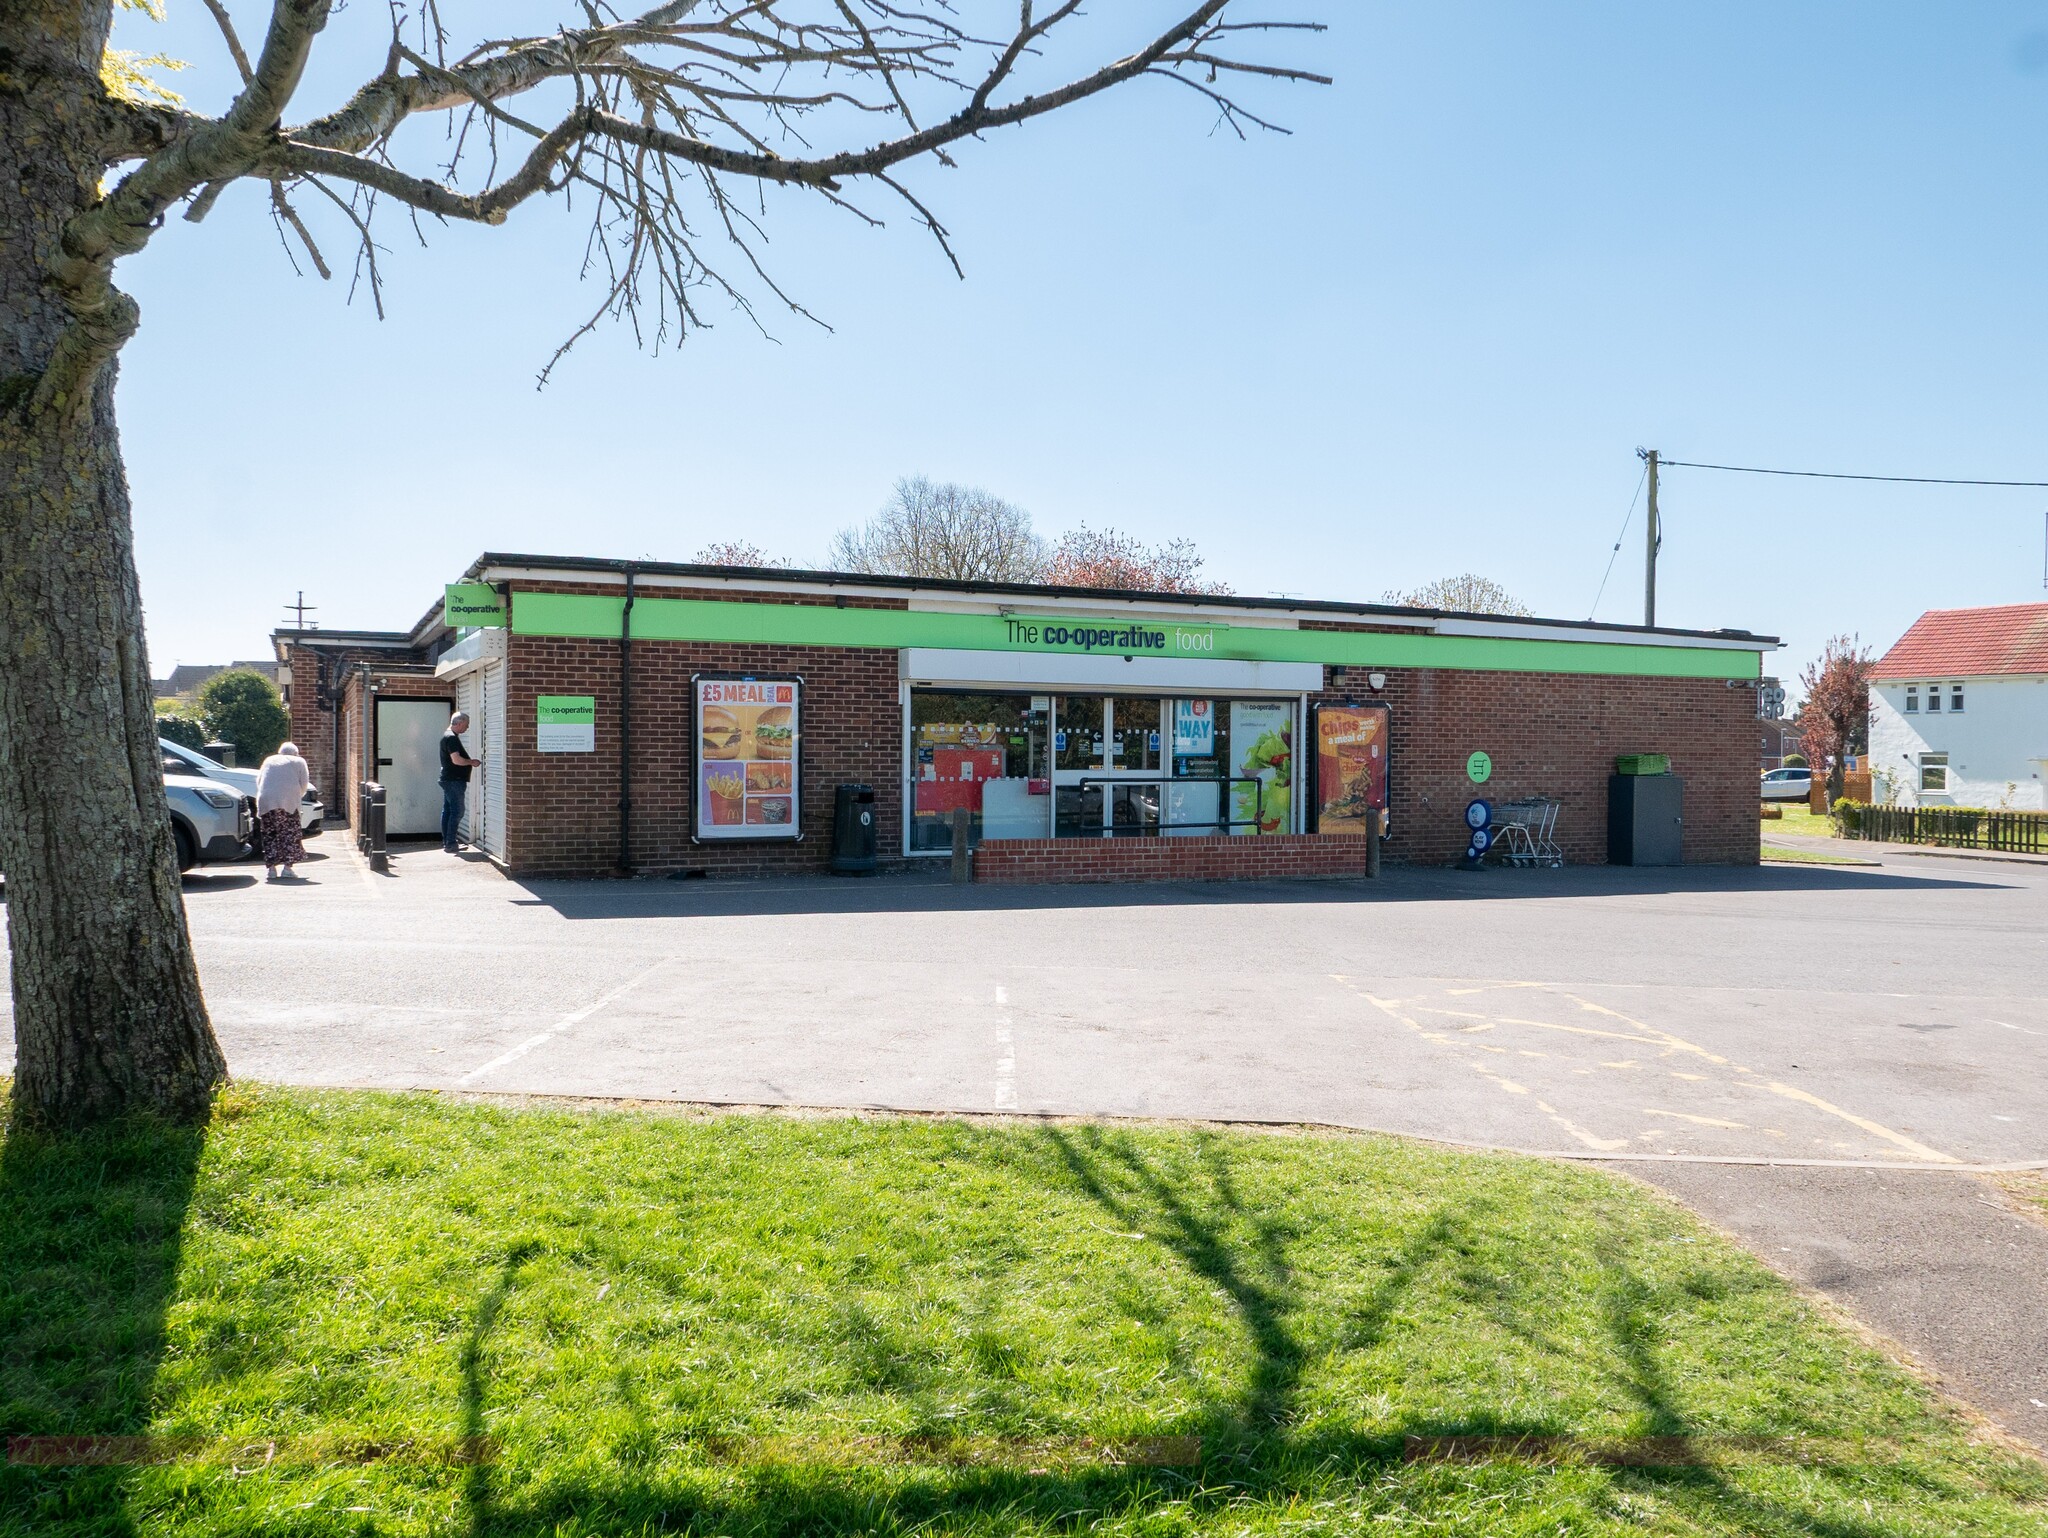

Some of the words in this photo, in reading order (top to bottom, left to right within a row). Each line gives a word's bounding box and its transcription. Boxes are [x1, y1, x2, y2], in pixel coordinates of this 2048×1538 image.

[451, 596, 464, 604] The
[451, 605, 500, 614] co-operative
[1004, 620, 1037, 643] The
[1043, 625, 1165, 650] co-operative
[1175, 628, 1213, 651] food
[702, 684, 721, 702] £5
[723, 685, 766, 702] MEAL
[539, 706, 550, 714] The
[551, 706, 593, 715] co-operative
[1179, 720, 1210, 738] WAY
[1328, 737, 1334, 745] a
[1335, 732, 1355, 743] meal
[1357, 731, 1366, 741] of
